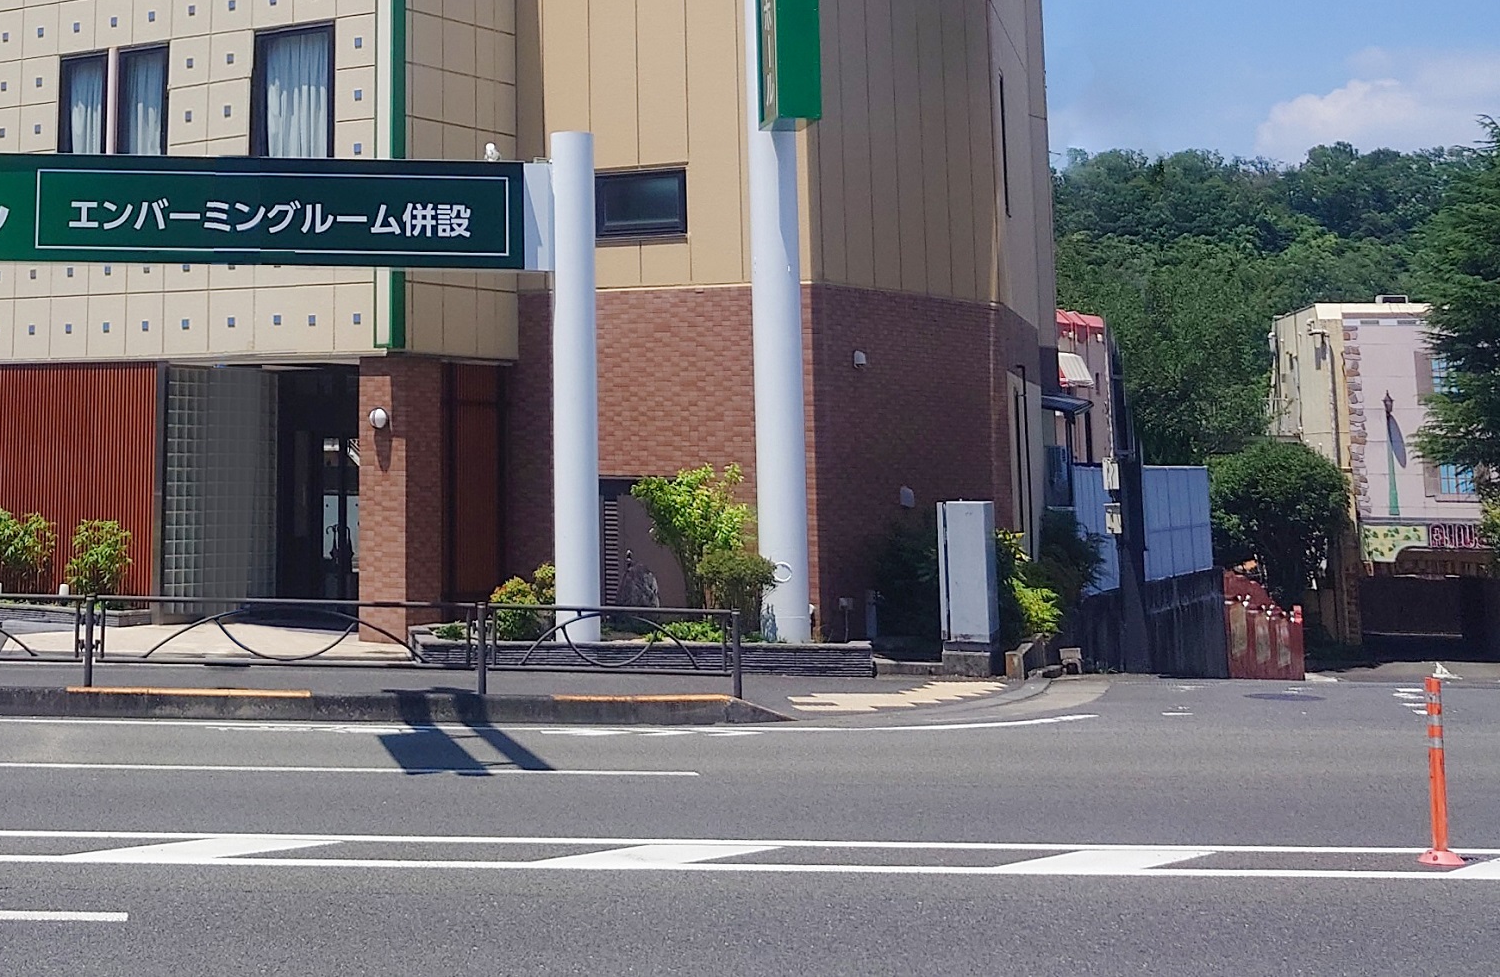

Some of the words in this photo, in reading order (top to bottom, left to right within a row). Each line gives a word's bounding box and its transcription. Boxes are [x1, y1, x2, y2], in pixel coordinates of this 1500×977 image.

[68, 199, 472, 239] エンバーミングルーム併設
